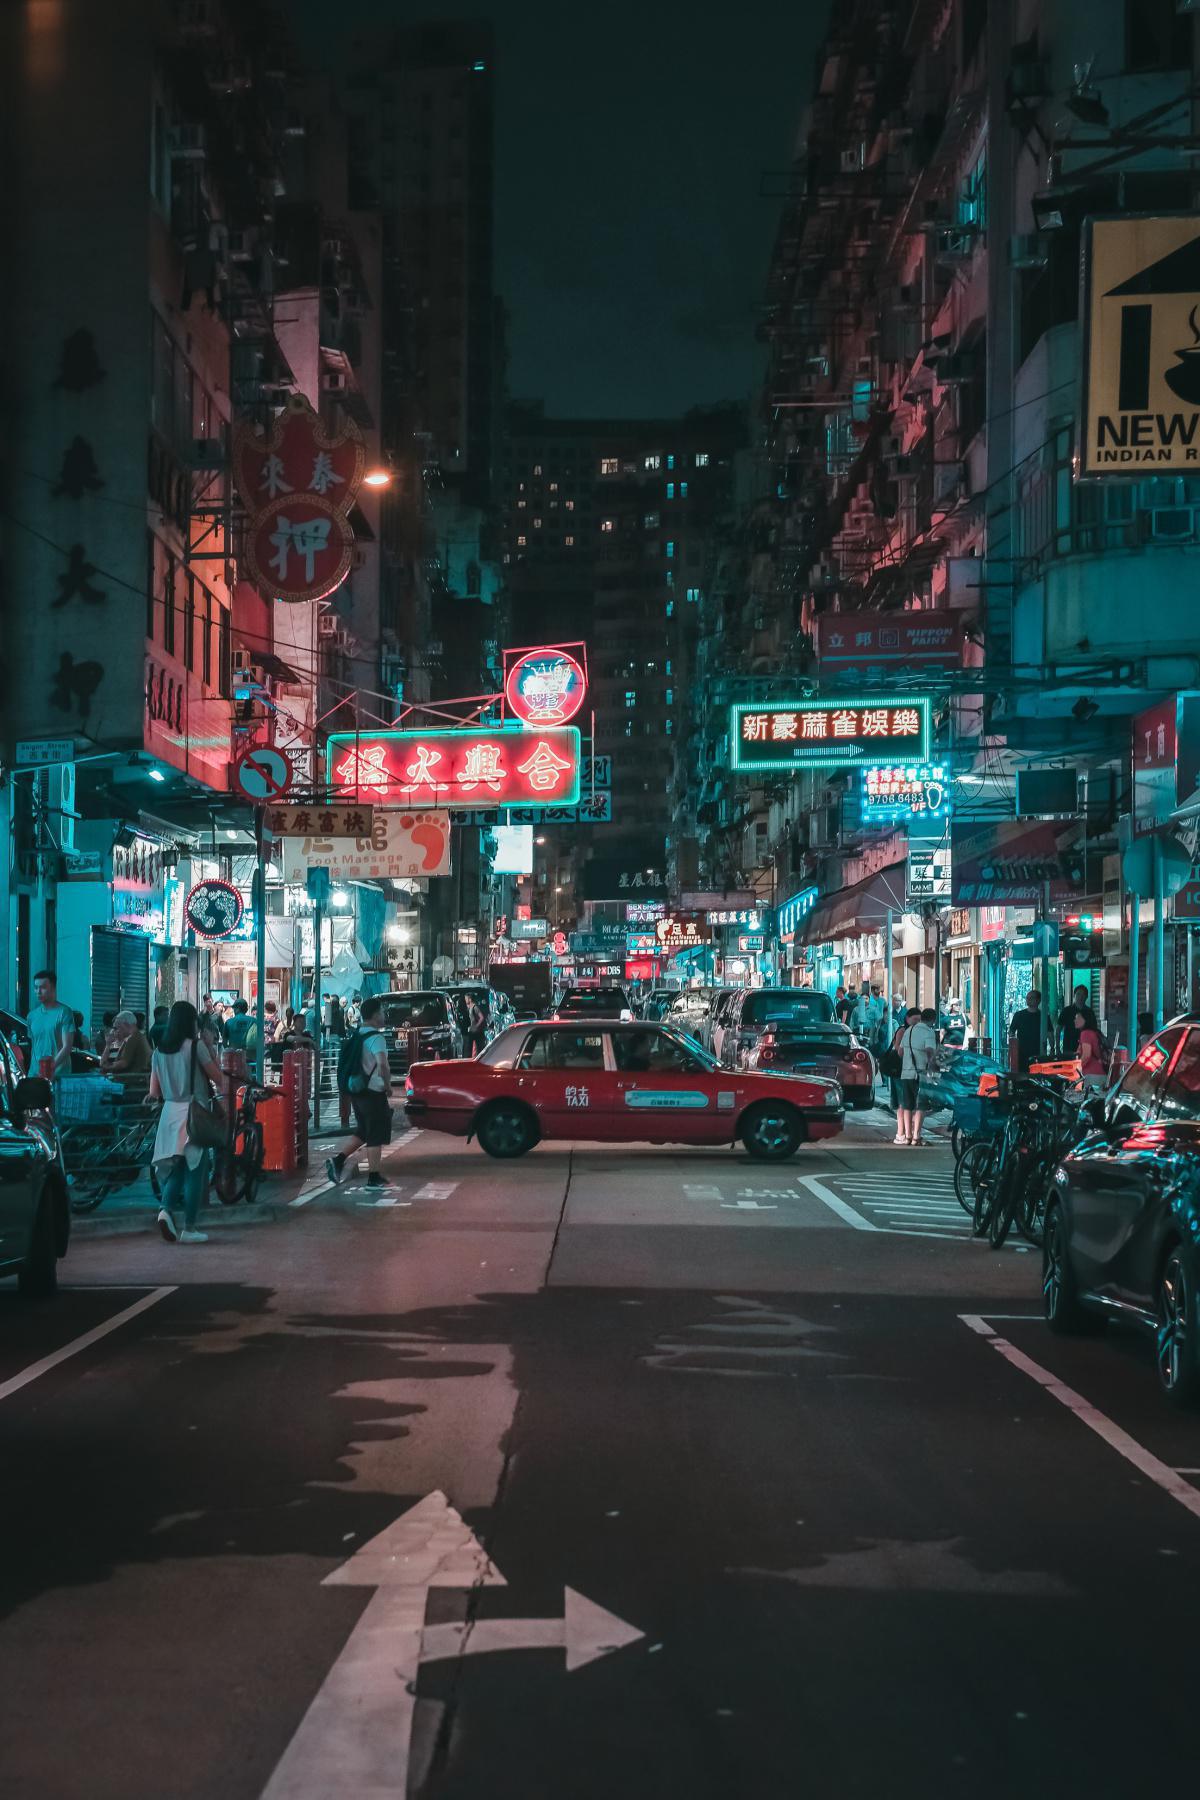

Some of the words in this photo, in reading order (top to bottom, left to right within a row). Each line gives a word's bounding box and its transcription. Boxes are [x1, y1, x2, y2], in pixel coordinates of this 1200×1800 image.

[1098, 414, 1200, 448] NEW
[1096, 449, 1171, 463] INDIAN
[269, 515, 331, 584] 押
[829, 631, 872, 648] 立邦
[906, 627, 953, 639] NIPPON
[911, 637, 947, 648] PAINT
[869, 794, 895, 805] 9706
[898, 792, 924, 803] 6483
[911, 802, 926, 813] 1/F
[307, 854, 337, 866] Foot
[342, 853, 403, 866] Massage
[293, 863, 418, 881] 足按摩專門店
[607, 966, 621, 976] DBS
[565, 1085, 589, 1096] 的士
[566, 1095, 589, 1107] TAXI
